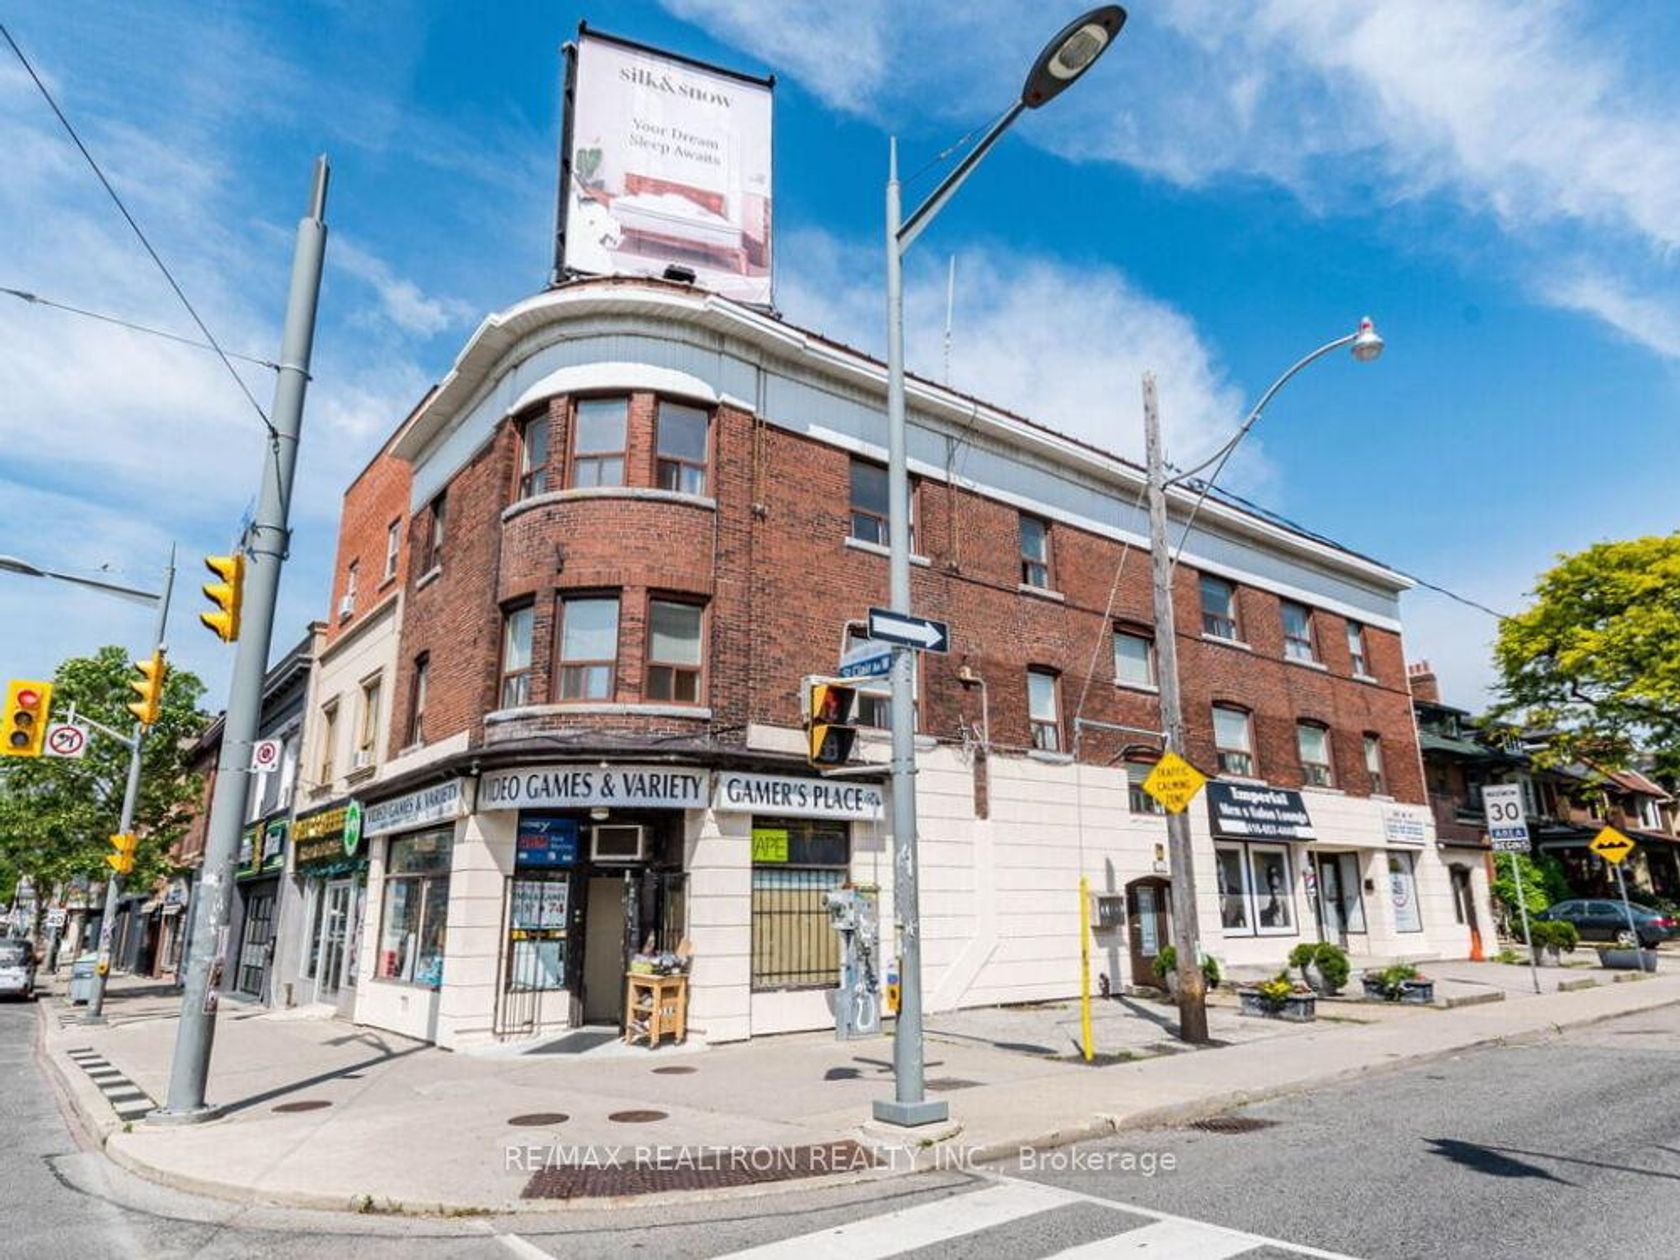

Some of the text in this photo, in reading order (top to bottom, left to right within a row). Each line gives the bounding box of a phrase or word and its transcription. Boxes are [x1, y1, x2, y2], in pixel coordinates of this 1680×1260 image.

[632, 118, 719, 149] Your Dream
[630, 134, 721, 165] Sleep Awaits
[526, 772, 593, 800] GAMES
[600, 773, 616, 797] &
[622, 773, 703, 799] VARIETY
[727, 779, 807, 808] GAMER'S
[813, 785, 863, 811] PLACE
[1490, 801, 1519, 821] 30
